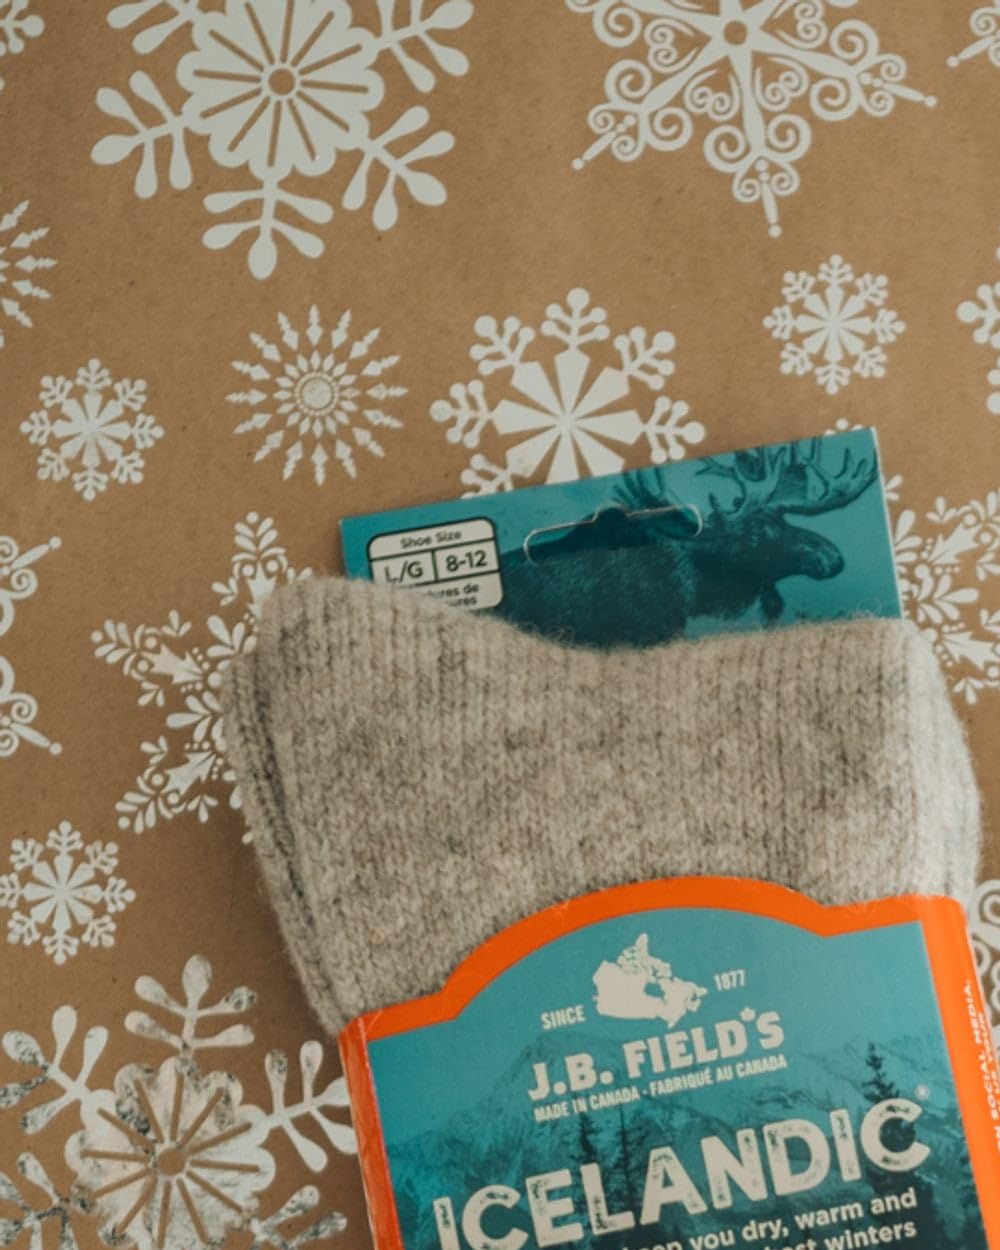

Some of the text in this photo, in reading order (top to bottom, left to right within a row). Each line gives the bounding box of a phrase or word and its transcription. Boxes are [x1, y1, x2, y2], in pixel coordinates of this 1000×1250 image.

[401, 531, 461, 549] Shoe Size
[445, 550, 487, 572] 8-12
[384, 561, 424, 583] L/G
[541, 969, 745, 1030] SINCE 1877
[528, 1053, 614, 1101] J.B.
[534, 1054, 788, 1123] MADE IN CANADA FABRIQUÉ AU CANADA
[741, 1219, 789, 1240] dry,
[794, 1201, 864, 1231] warm
[870, 1186, 918, 1215] and
